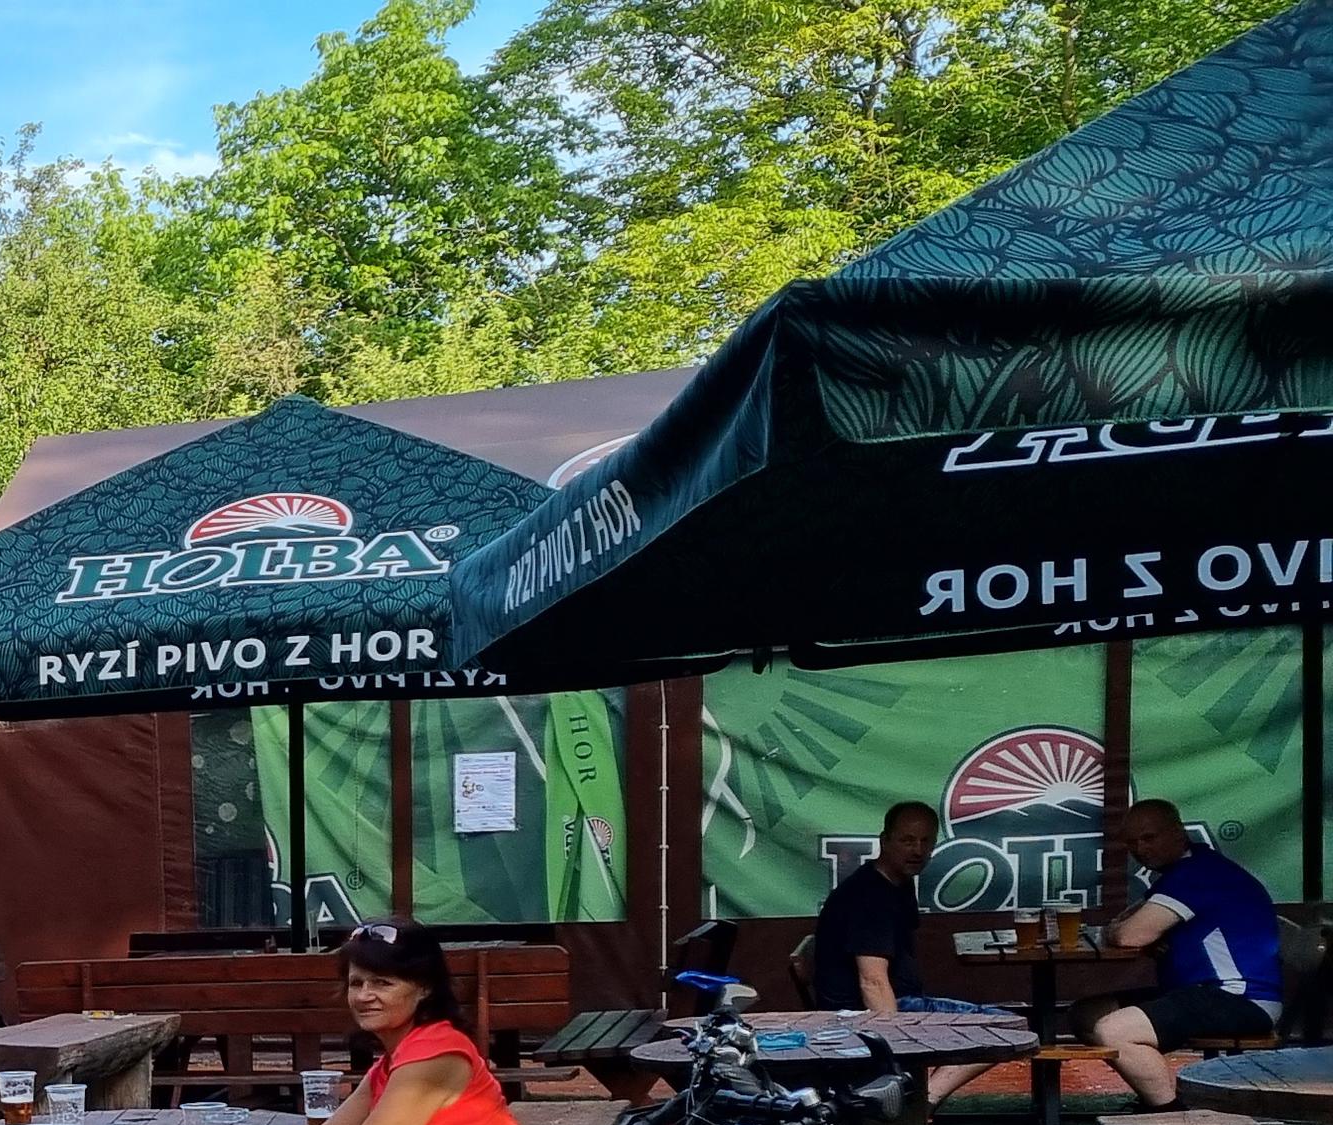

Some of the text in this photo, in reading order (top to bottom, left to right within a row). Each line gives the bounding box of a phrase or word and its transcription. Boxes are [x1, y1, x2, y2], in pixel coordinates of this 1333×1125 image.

[55, 530, 451, 603] HOLBA
[505, 479, 641, 614] RYZÍ PIVO Z HOR
[38, 628, 438, 685] RYZÍ PIVO Z HOR
[569, 714, 597, 784] HOR
